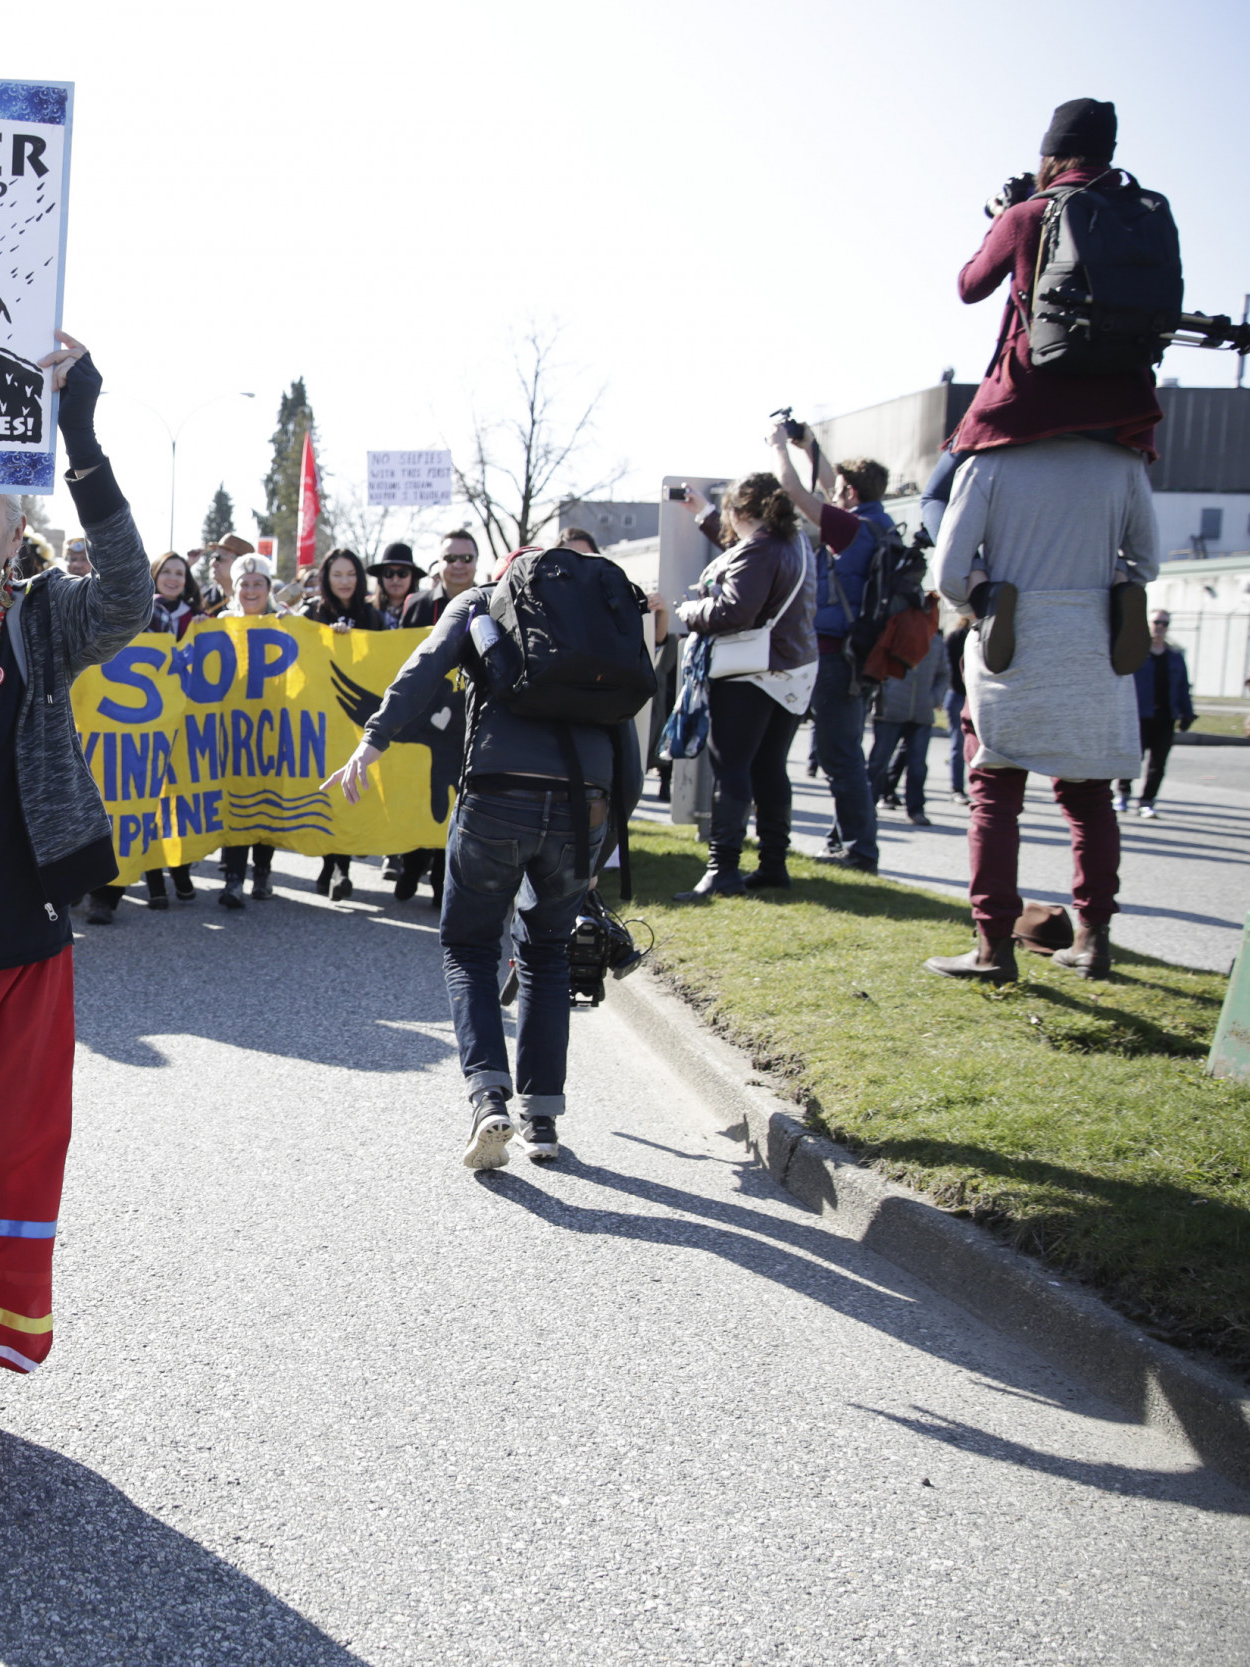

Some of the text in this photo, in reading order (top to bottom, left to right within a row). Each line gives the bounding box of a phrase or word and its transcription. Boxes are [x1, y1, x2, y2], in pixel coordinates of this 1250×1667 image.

[372, 452, 443, 466] NO SELFIES
[370, 467, 451, 479] WITH THIS FIRST
